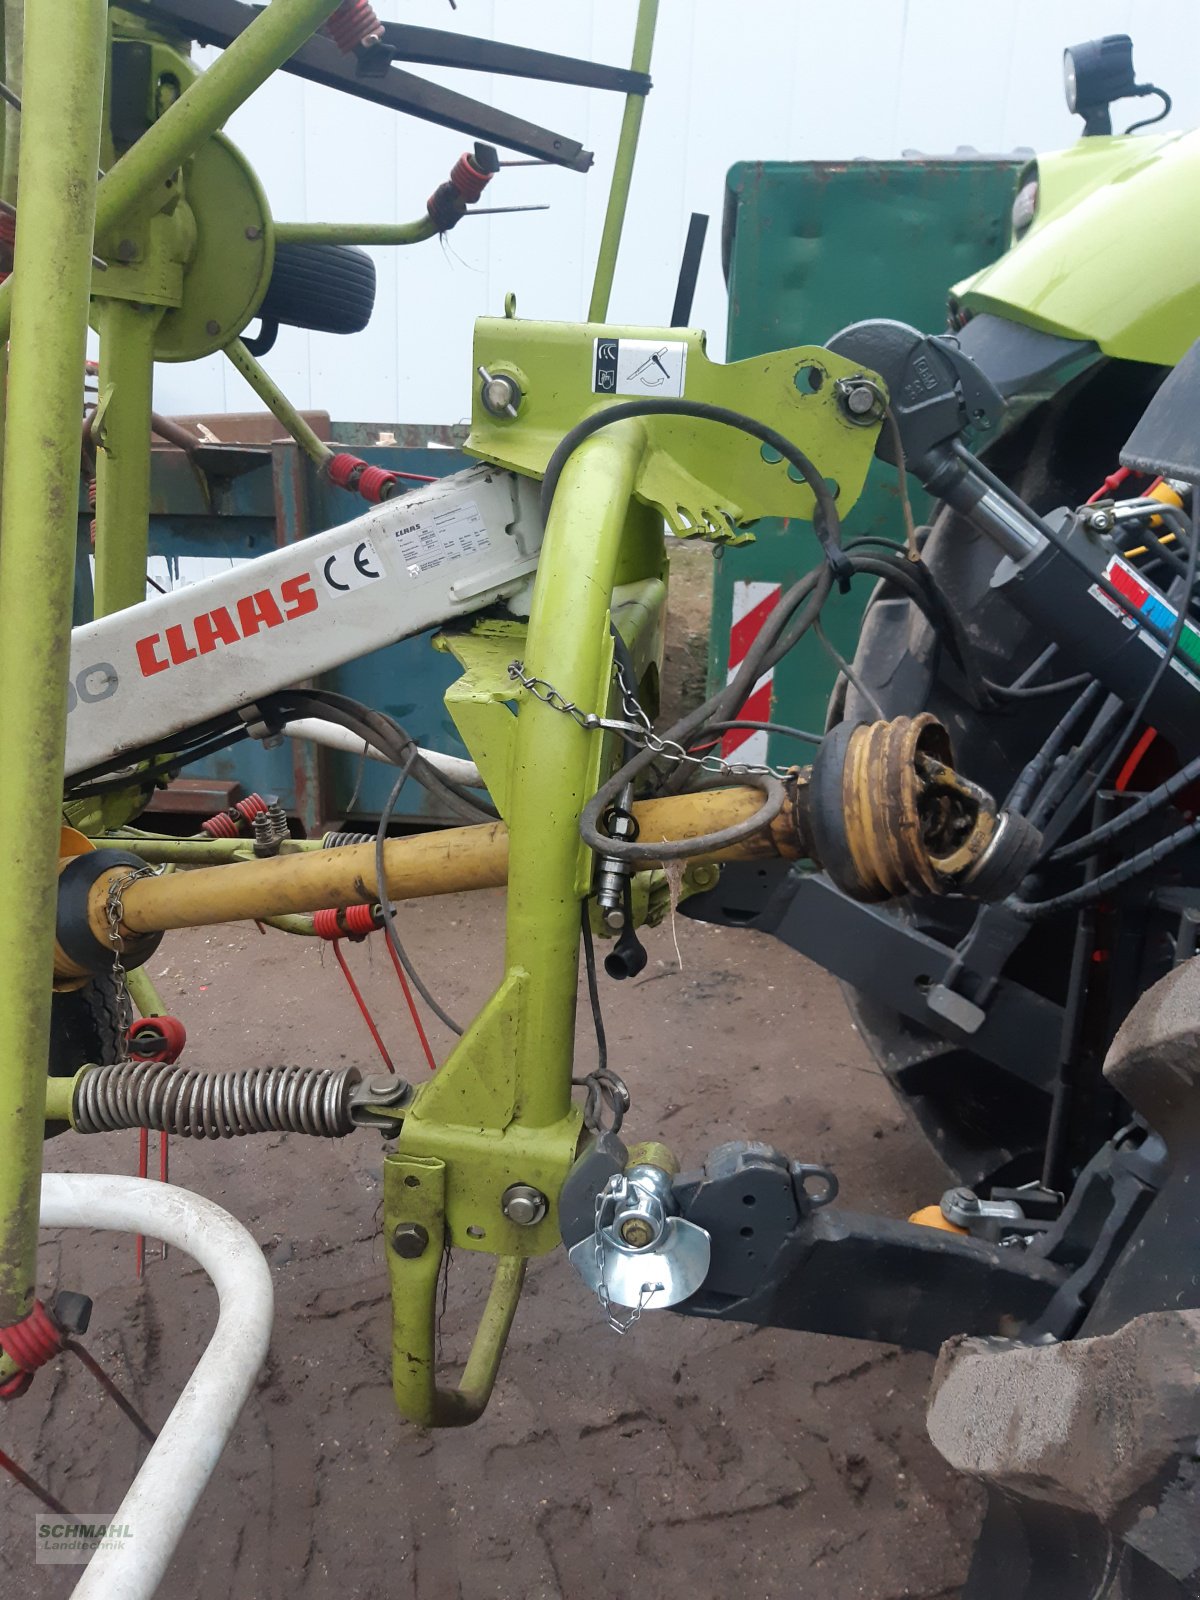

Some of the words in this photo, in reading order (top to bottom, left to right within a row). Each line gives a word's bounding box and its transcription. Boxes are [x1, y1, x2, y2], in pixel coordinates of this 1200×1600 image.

[395, 523, 421, 538] CLAAS
[323, 542, 380, 591] CE
[136, 572, 319, 678] CLAAS
